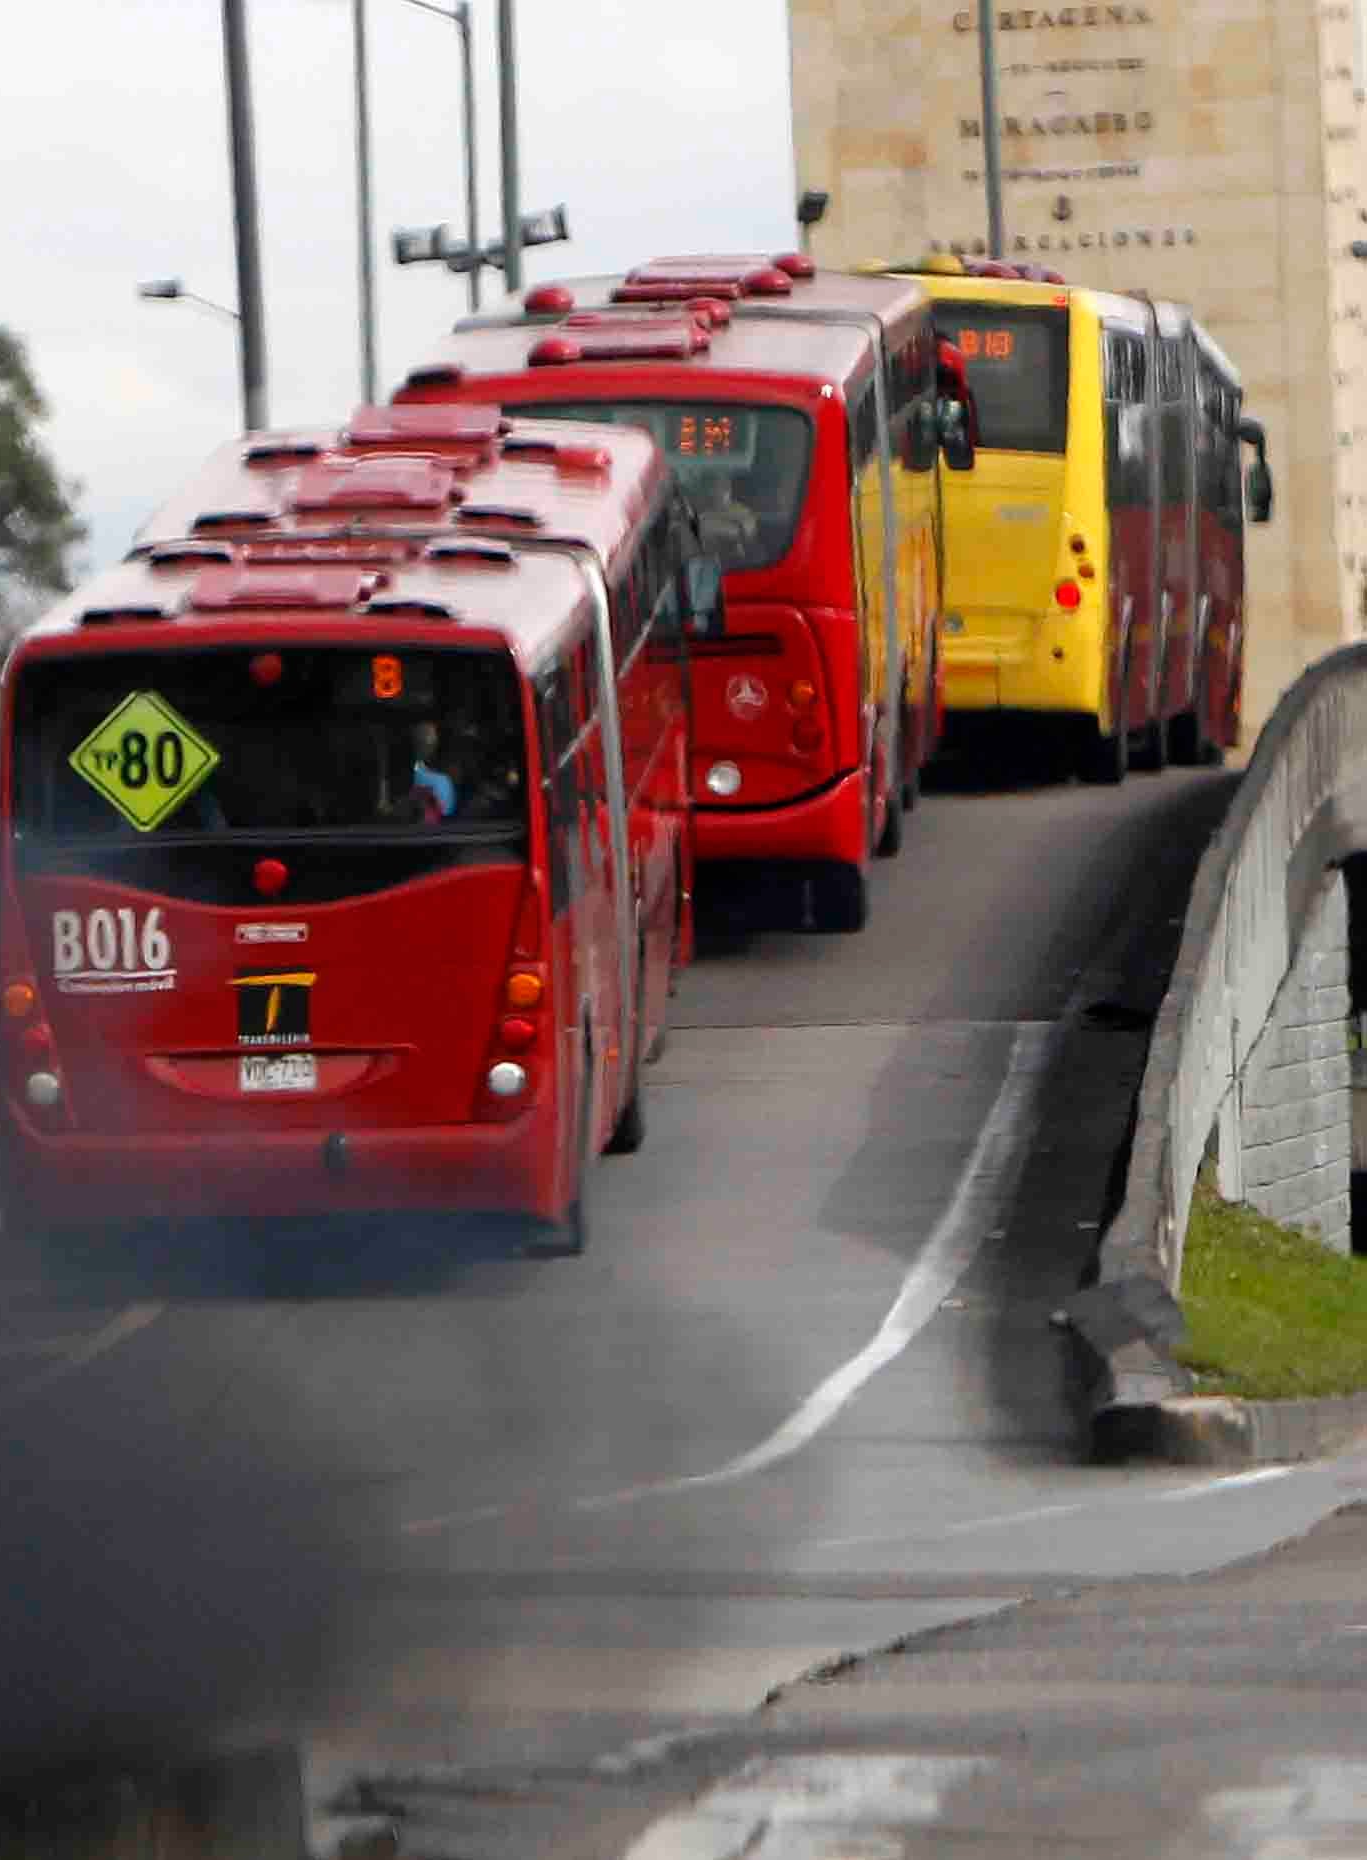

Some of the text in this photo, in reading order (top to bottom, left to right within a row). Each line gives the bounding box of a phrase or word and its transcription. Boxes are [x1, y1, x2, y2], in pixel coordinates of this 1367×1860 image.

[951, 6, 1153, 34] CRTAGENA
[120, 730, 183, 789] 80
[53, 907, 171, 971] B016
